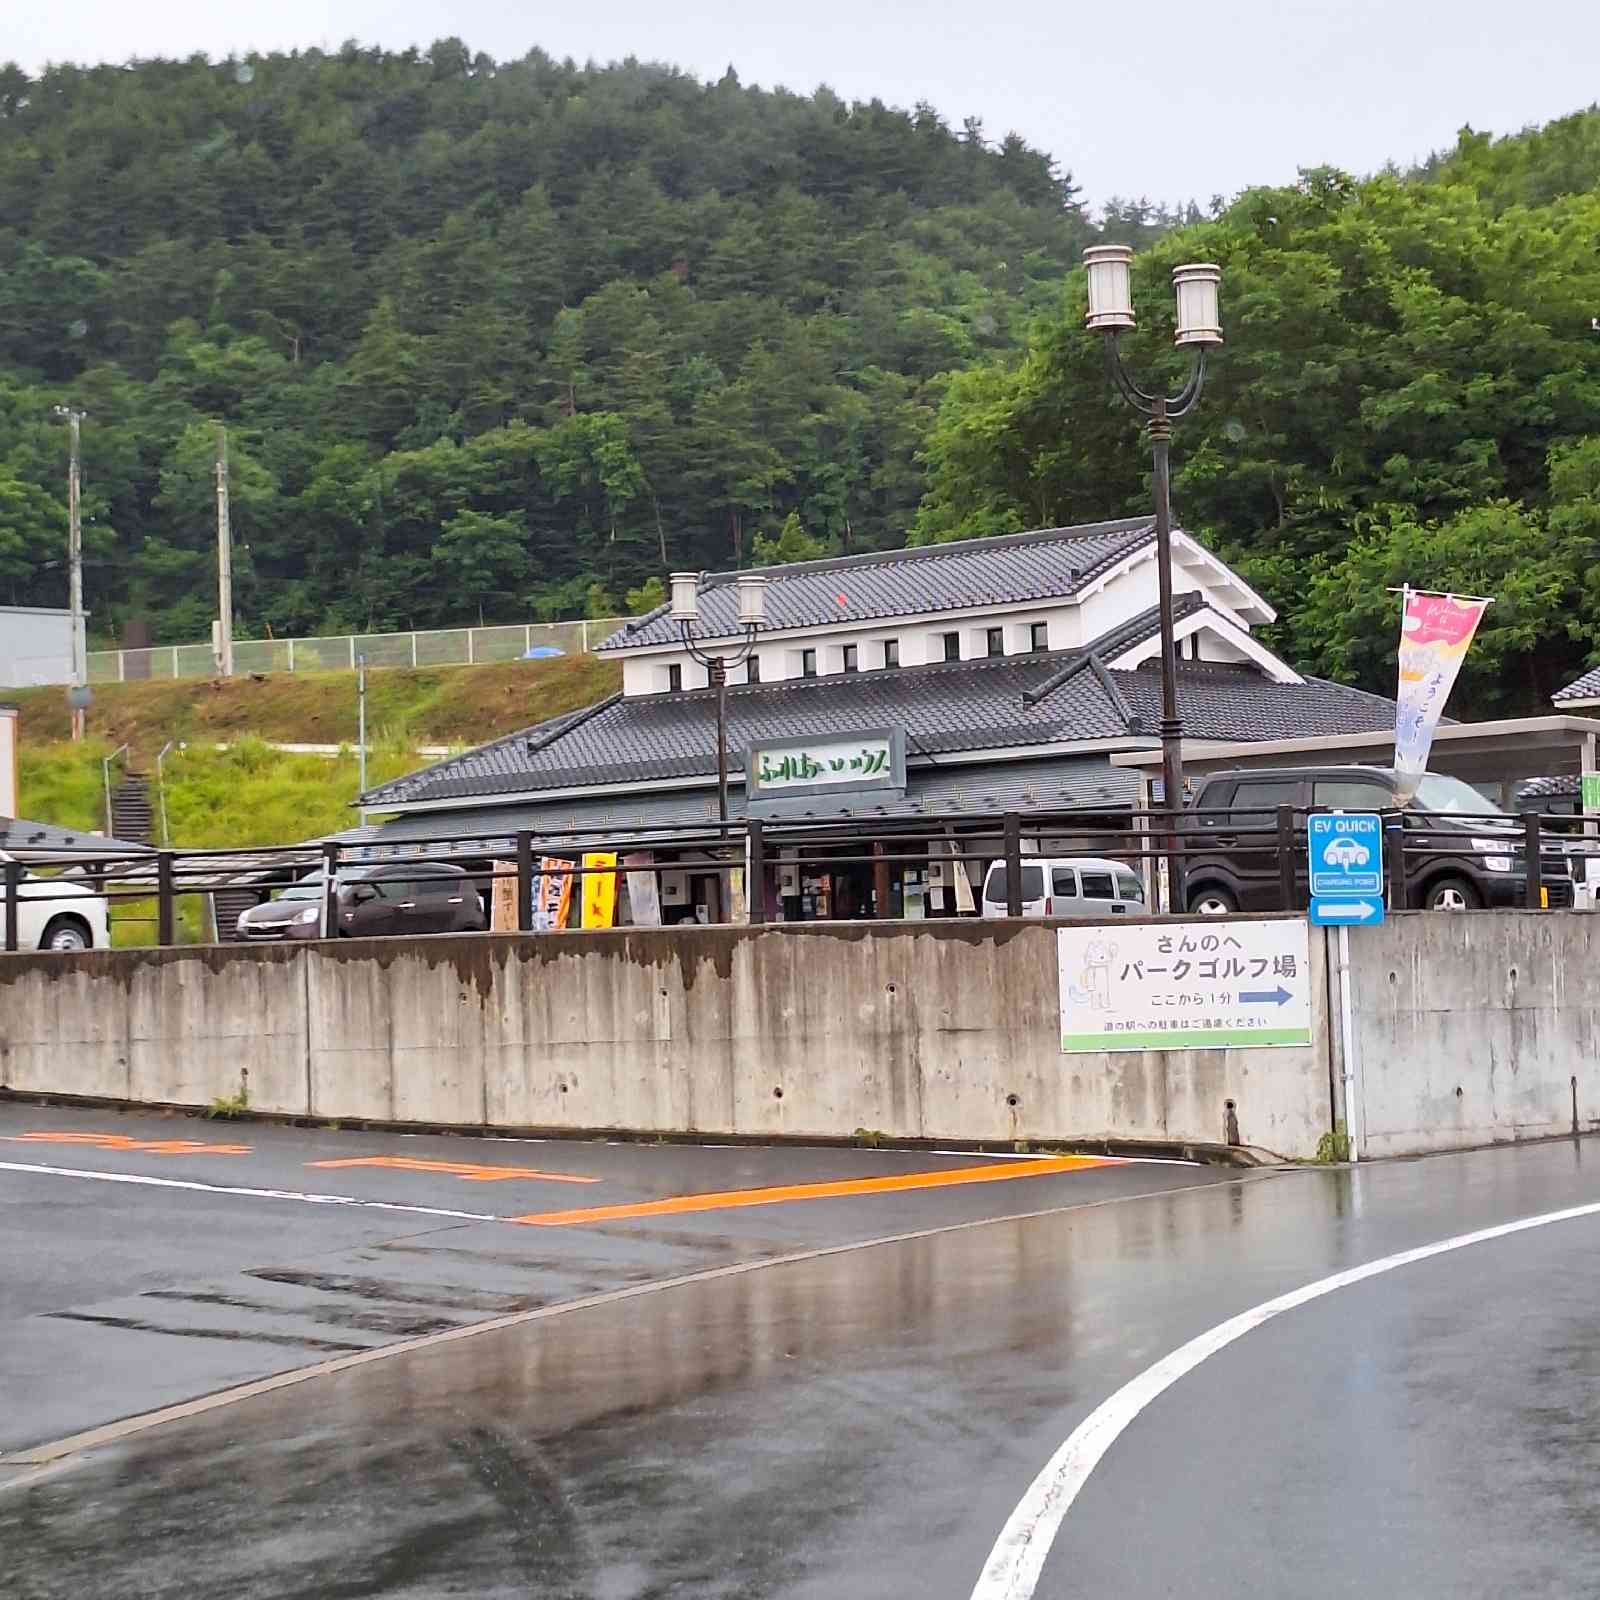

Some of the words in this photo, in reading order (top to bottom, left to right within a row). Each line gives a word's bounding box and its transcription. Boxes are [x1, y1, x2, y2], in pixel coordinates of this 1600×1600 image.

[1314, 820, 1331, 832] EV
[1335, 820, 1376, 832] QUICK
[1157, 935, 1243, 953] さんのへ
[1120, 954, 1297, 981] パークゴルフ場
